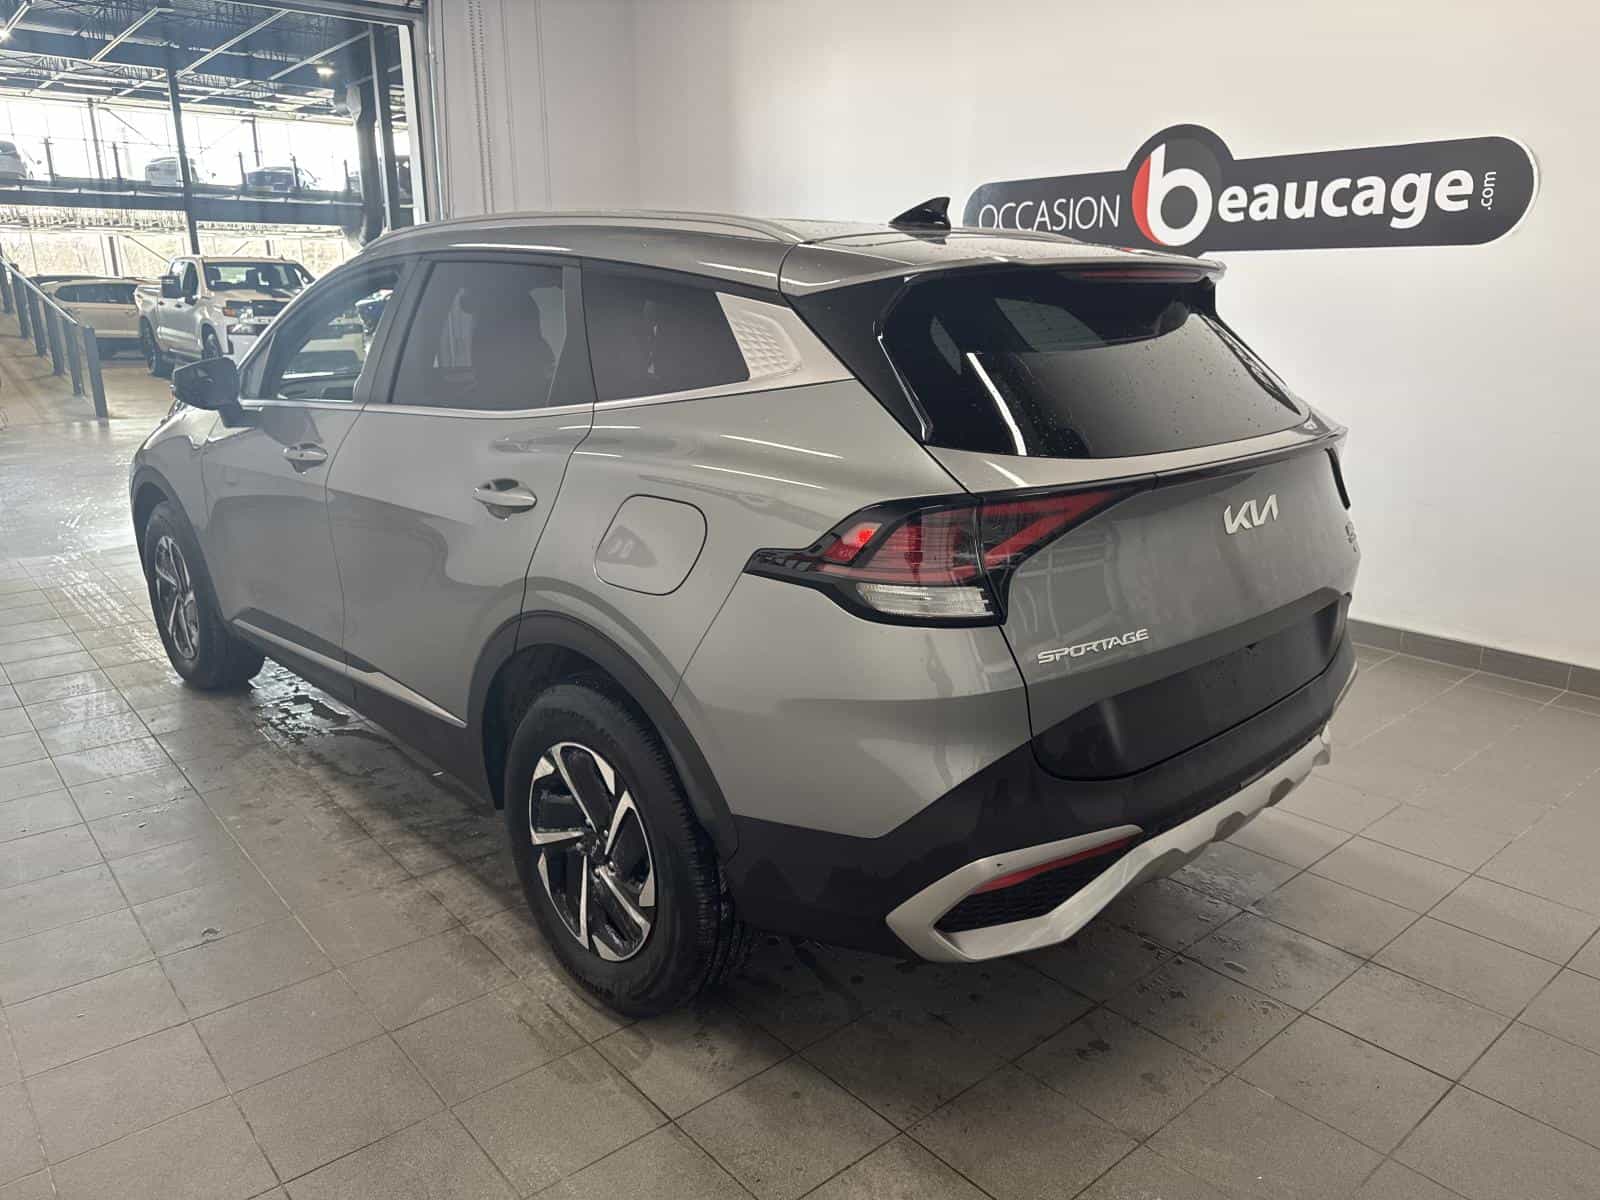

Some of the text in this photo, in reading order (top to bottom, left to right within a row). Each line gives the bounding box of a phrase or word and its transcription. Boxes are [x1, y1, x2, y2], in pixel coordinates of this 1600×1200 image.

[978, 194, 1121, 232] OCCASION
[1146, 143, 1474, 247] beaucage
[1224, 494, 1279, 535] KIA
[1037, 628, 1150, 665] SPORTAGE
